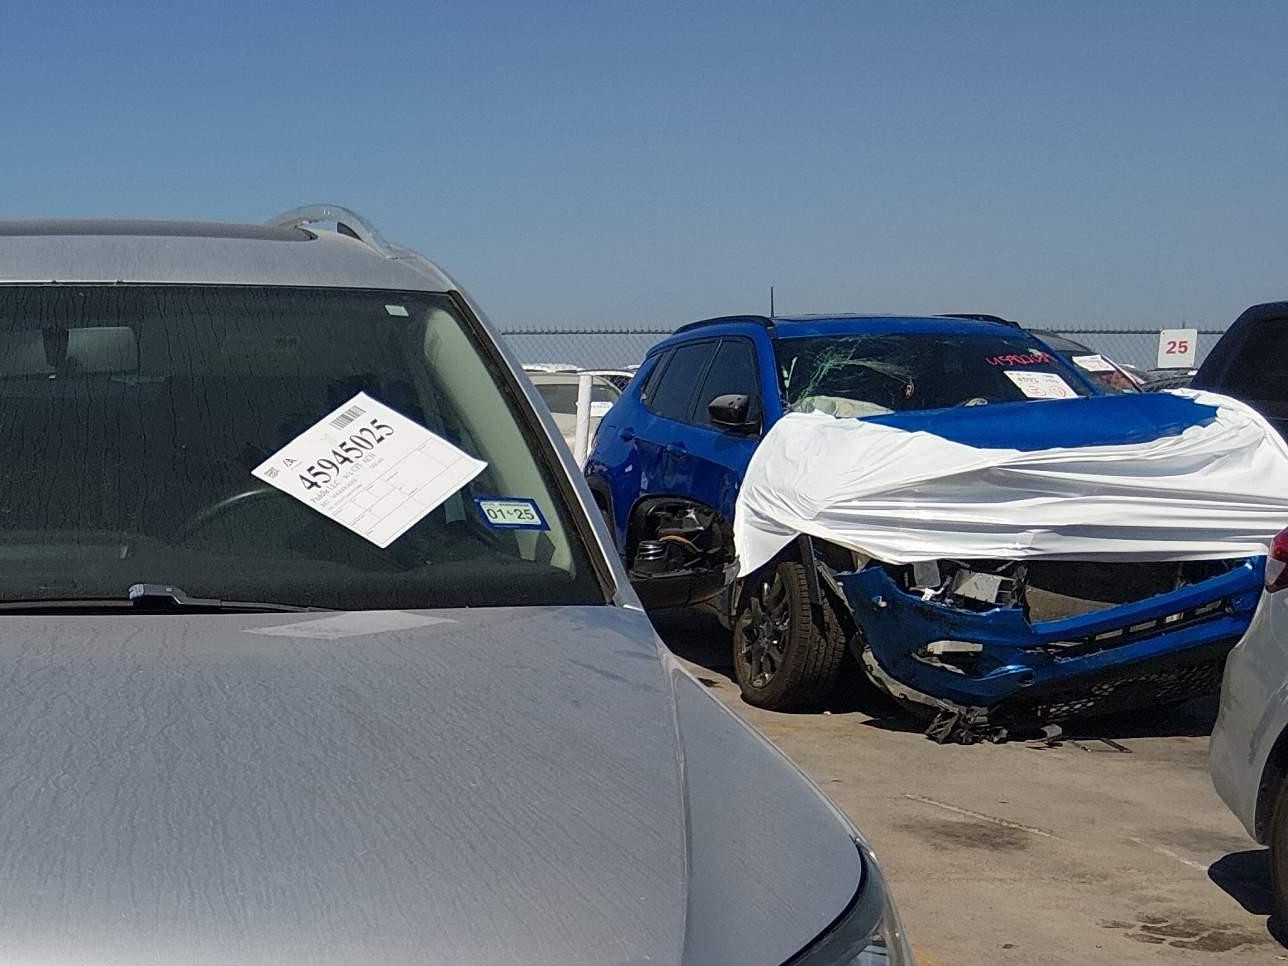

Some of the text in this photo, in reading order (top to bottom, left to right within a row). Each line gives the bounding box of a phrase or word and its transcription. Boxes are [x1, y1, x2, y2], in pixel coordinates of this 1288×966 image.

[1165, 340, 1189, 354] 25
[298, 418, 394, 491] 45945025
[486, 508, 535, 520] 01 25
